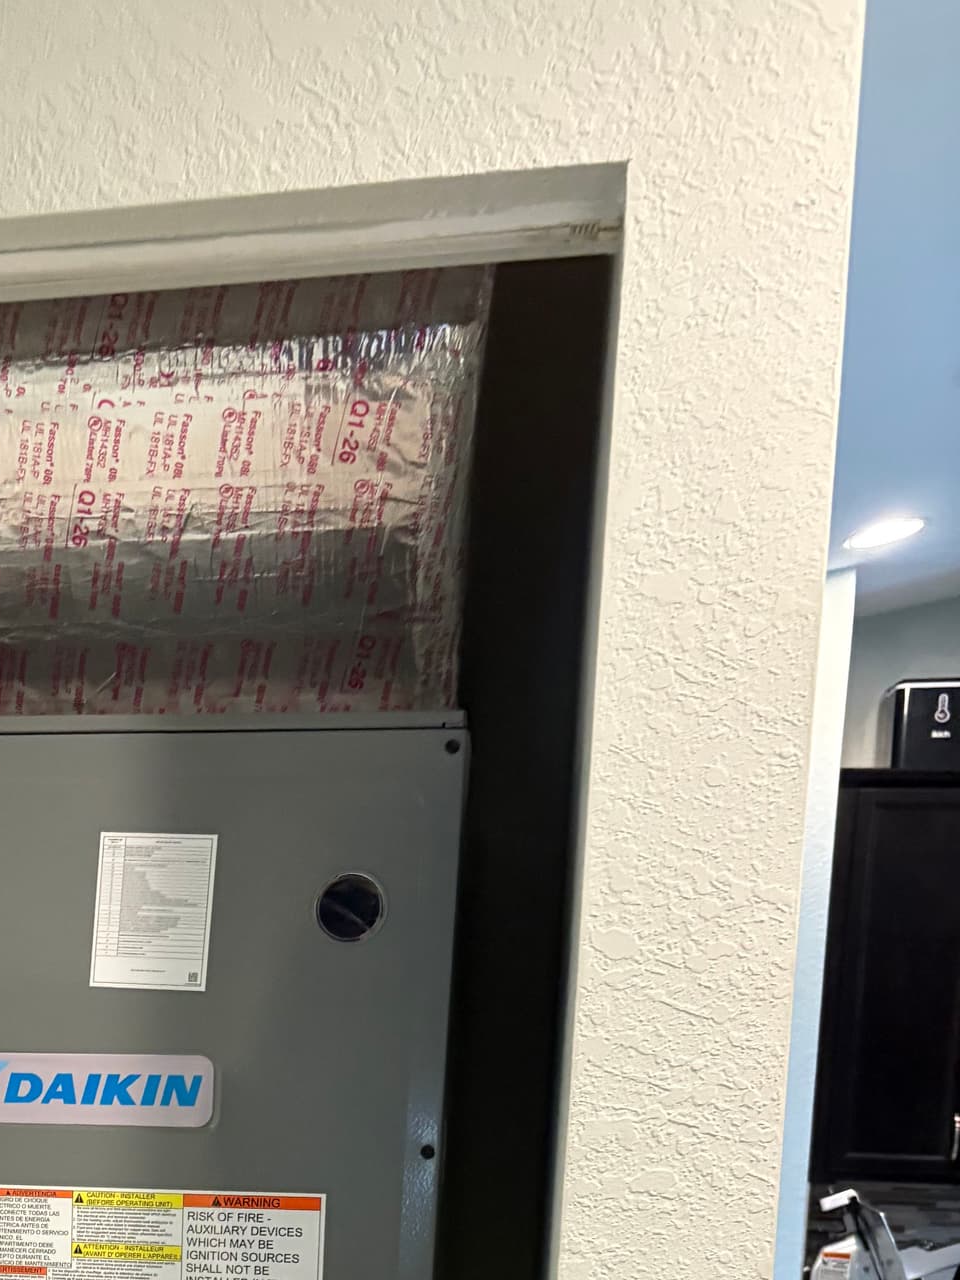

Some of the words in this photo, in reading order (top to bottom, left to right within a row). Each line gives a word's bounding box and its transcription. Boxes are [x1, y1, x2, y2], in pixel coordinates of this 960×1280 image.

[339, 400, 369, 465] Q1-26
[72, 491, 96, 548] Q1-26
[4, 1072, 202, 1106] DAIKIN
[224, 1197, 280, 1208] WARNING
[188, 1212, 215, 1221] RISK
[218, 1212, 234, 1222] OF
[238, 1213, 264, 1222] FIRE
[187, 1225, 248, 1235] AUXILIARY
[251, 1226, 302, 1237] DEVICES
[187, 1238, 227, 1248] WHICH
[230, 1239, 255, 1249] MAY
[258, 1240, 273, 1249] BE
[187, 1251, 238, 1261] IGNITION
[242, 1252, 299, 1263] SOURCES
[186, 1263, 223, 1273] SHALL
[226, 1265, 251, 1274] NOT
[254, 1265, 269, 1275] BE
